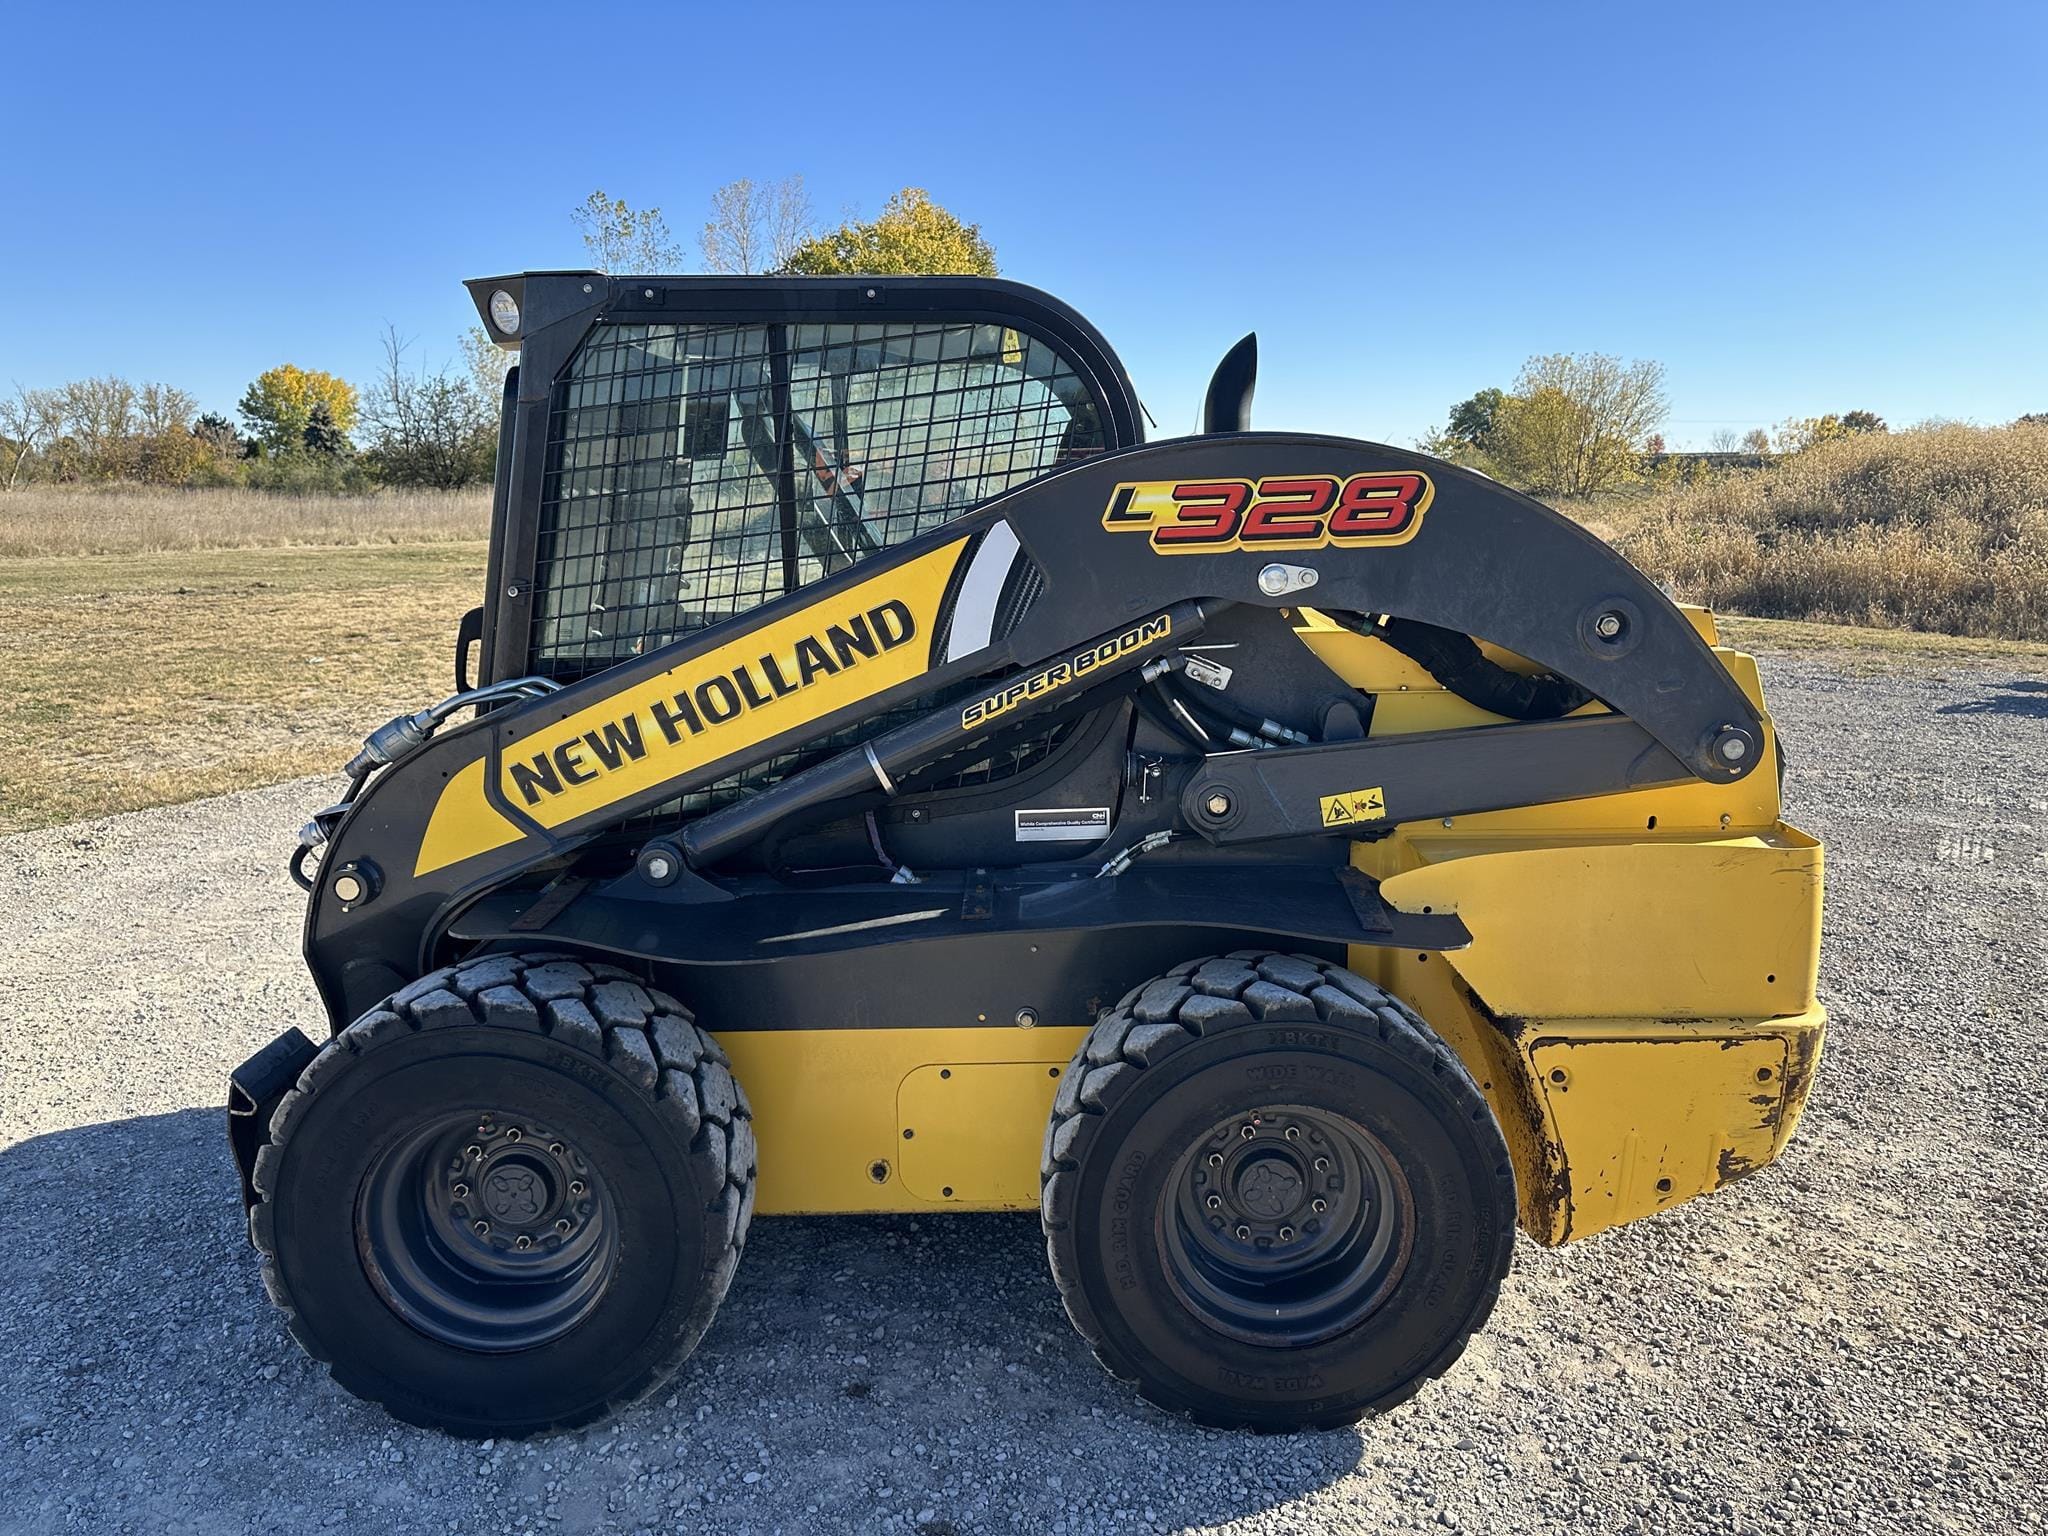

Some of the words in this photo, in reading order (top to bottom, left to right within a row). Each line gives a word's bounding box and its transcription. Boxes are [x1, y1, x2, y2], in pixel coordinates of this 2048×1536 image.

[507, 711, 648, 807] NEW
[650, 598, 918, 746] HOLLAND
[961, 662, 1072, 731] SUPER
[1073, 614, 1172, 678] BOOM
[1284, 1030, 1324, 1046] BKT
[1246, 1063, 1298, 1082] WIDE
[1112, 1150, 1147, 1215] GUARD
[1111, 1217, 1128, 1253] RIM
[1423, 1250, 1457, 1310] GUARD
